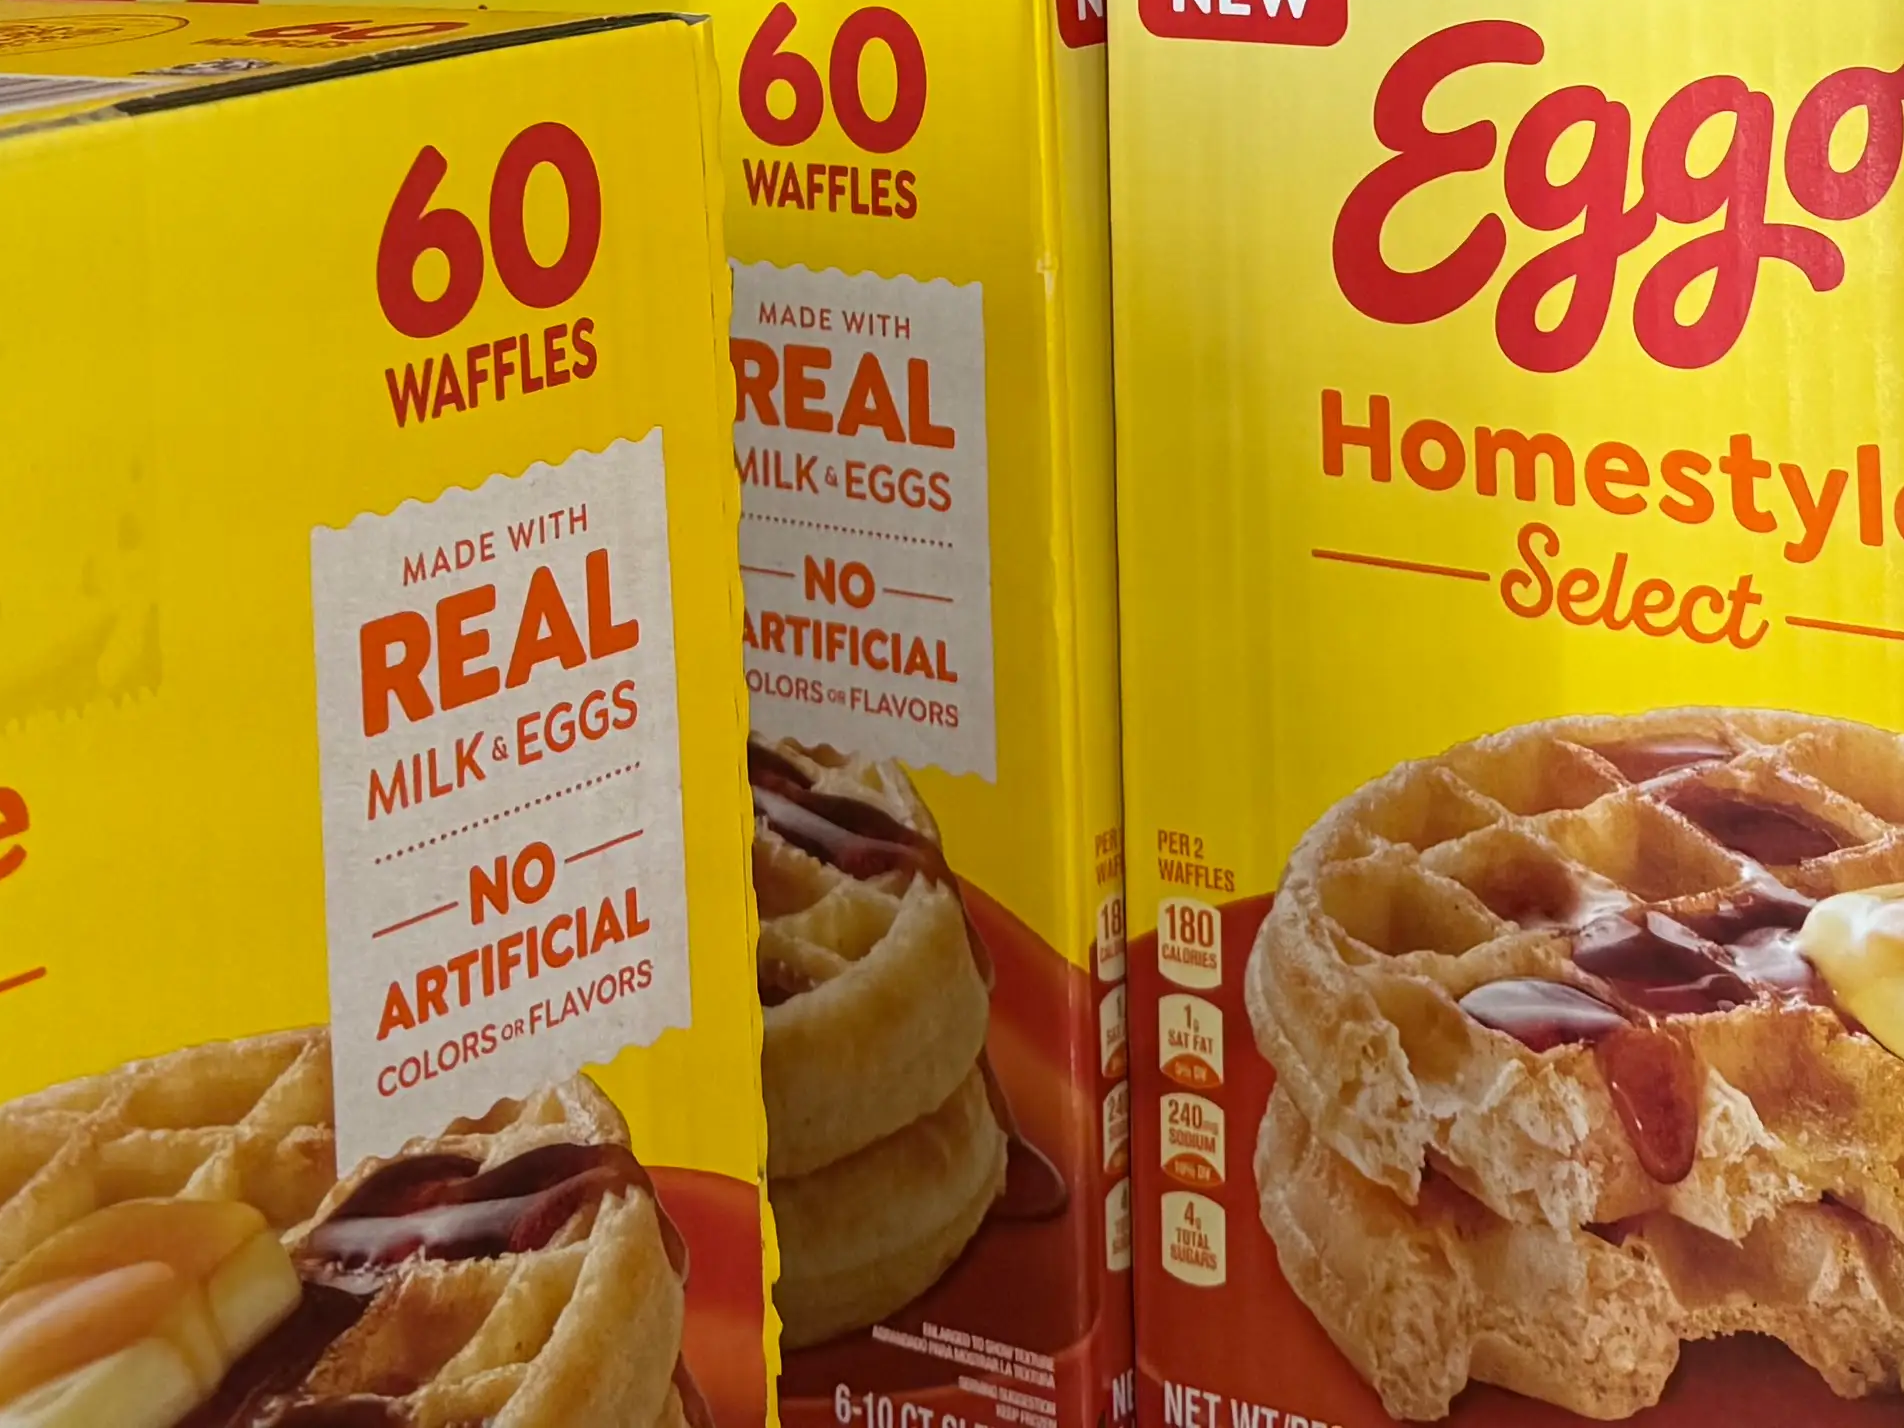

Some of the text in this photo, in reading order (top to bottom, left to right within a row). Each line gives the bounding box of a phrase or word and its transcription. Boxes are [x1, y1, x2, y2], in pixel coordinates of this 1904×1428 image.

[740, 2, 926, 154] 60
[373, 116, 606, 343] 60
[742, 160, 916, 218] WAFFLES
[383, 316, 600, 430] WAFFLES
[358, 548, 641, 739] REAL
[805, 556, 874, 608] NO
[1501, 523, 1769, 648] Select
[375, 887, 649, 1042] ARTIFICIAL
